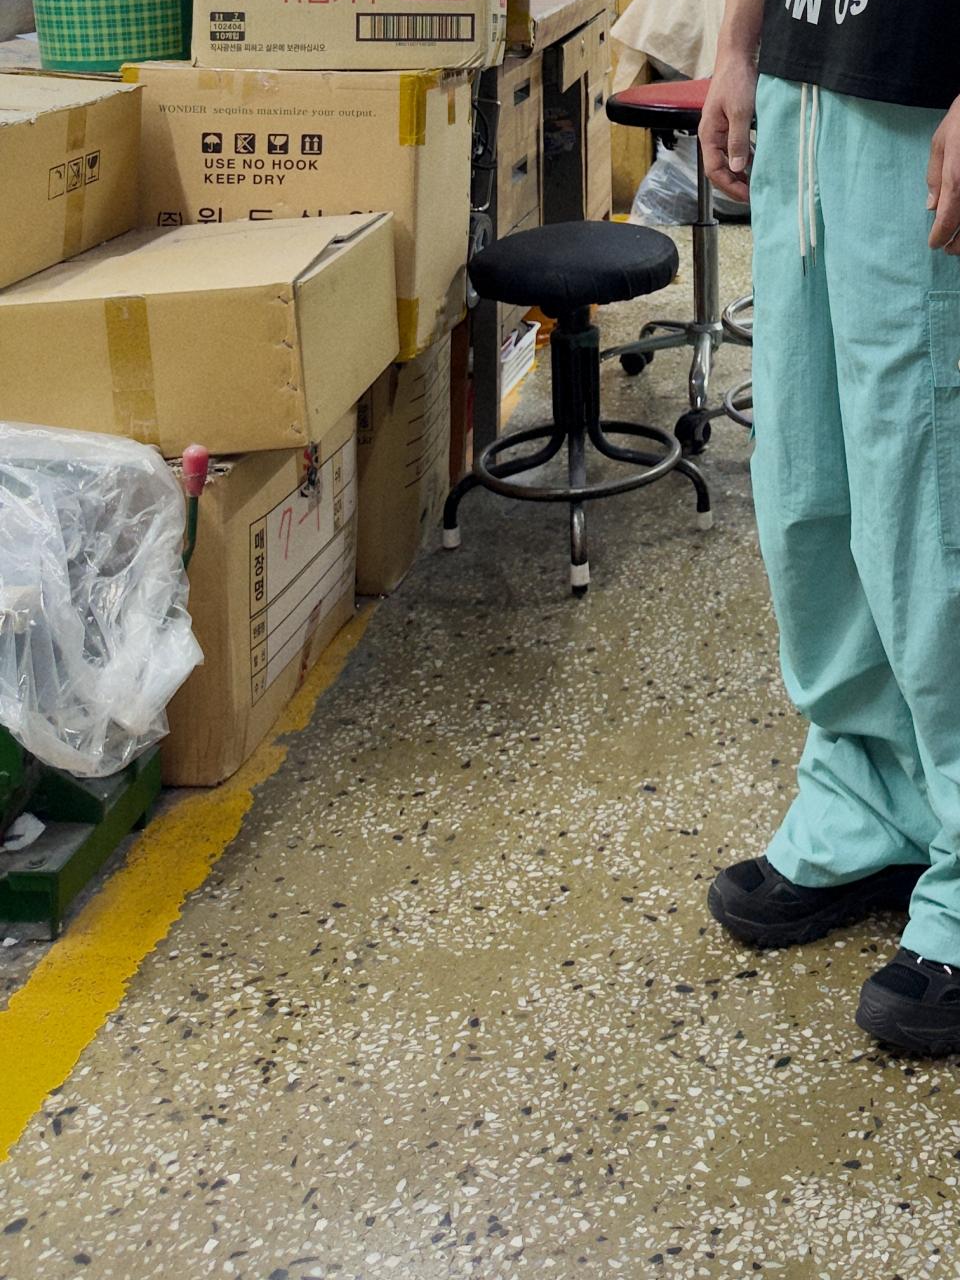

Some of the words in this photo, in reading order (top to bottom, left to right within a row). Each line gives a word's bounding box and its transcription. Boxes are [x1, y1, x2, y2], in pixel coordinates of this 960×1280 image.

[158, 104, 207, 114] WONDER
[205, 159, 236, 170] USE
[243, 159, 265, 170] NO
[272, 159, 319, 171] HOOK
[204, 174, 247, 185] KEEP
[253, 174, 286, 185] DRY
